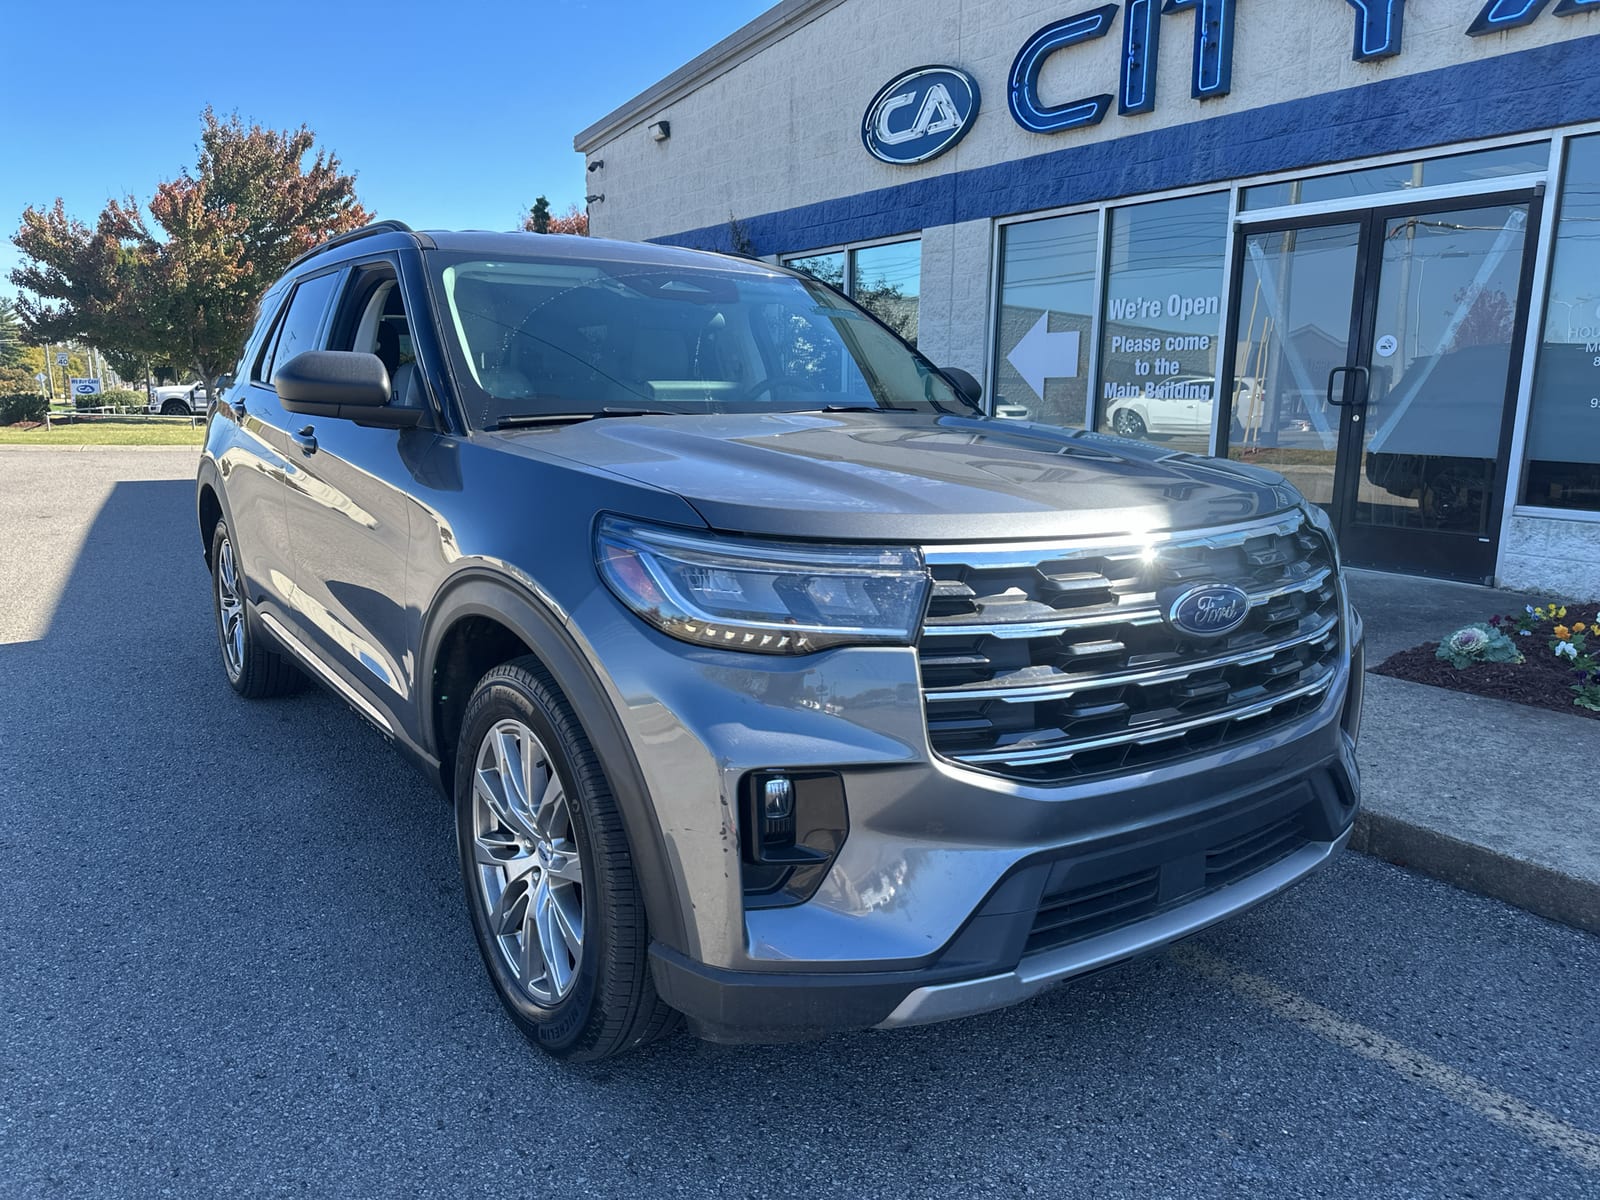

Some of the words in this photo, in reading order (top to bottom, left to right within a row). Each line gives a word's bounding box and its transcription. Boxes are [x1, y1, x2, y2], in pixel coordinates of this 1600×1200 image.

[875, 83, 962, 145] CA
[1108, 297, 1162, 321] We're
[1167, 294, 1218, 320] Open
[1112, 335, 1161, 353] Please
[1165, 335, 1209, 351] come
[1585, 342, 1600, 353] M
[1135, 359, 1150, 376] to
[1155, 358, 1180, 375] the
[1104, 382, 1140, 399] Main
[1144, 382, 1210, 401] Building
[1195, 594, 1237, 625] Ford
